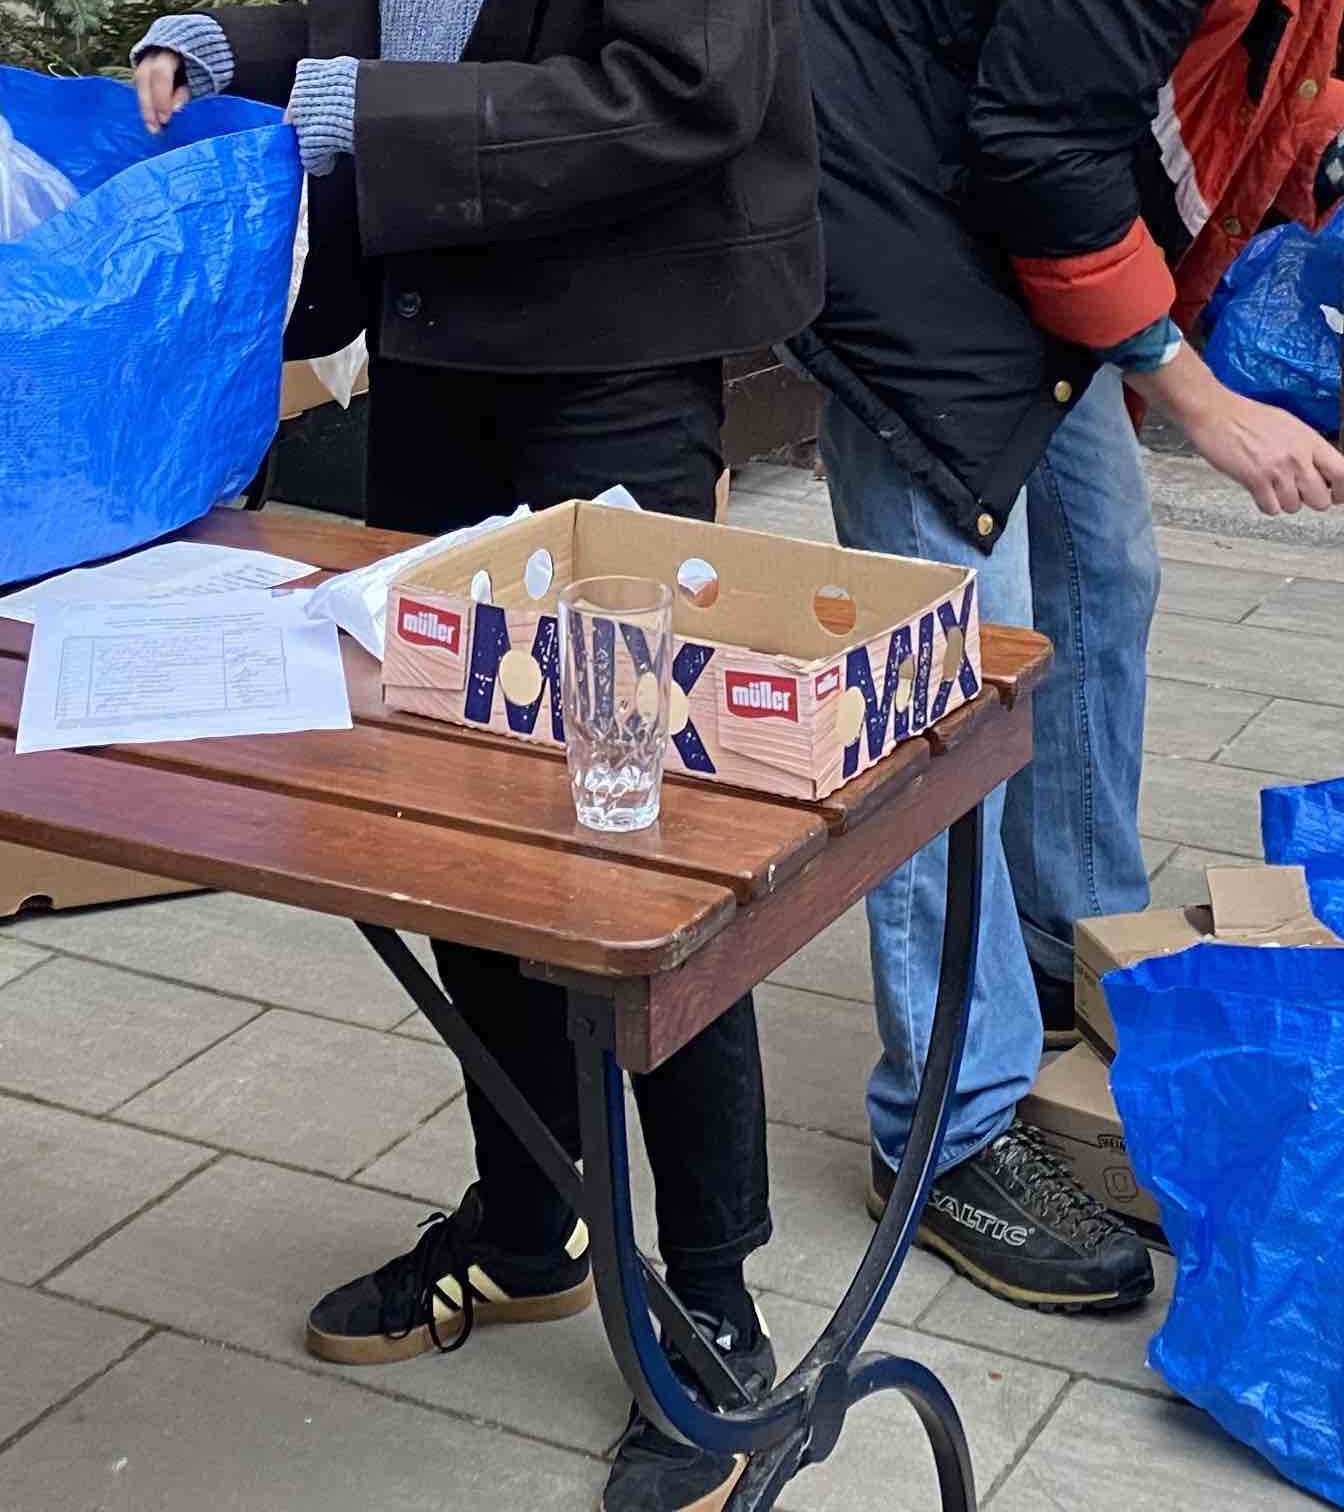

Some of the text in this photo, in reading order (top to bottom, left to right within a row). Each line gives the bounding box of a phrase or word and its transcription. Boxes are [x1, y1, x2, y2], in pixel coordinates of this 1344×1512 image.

[402, 610, 457, 646] müller
[732, 681, 794, 714] müller
[842, 582, 981, 779] MIX
[928, 1191, 1028, 1247] ALTIC
